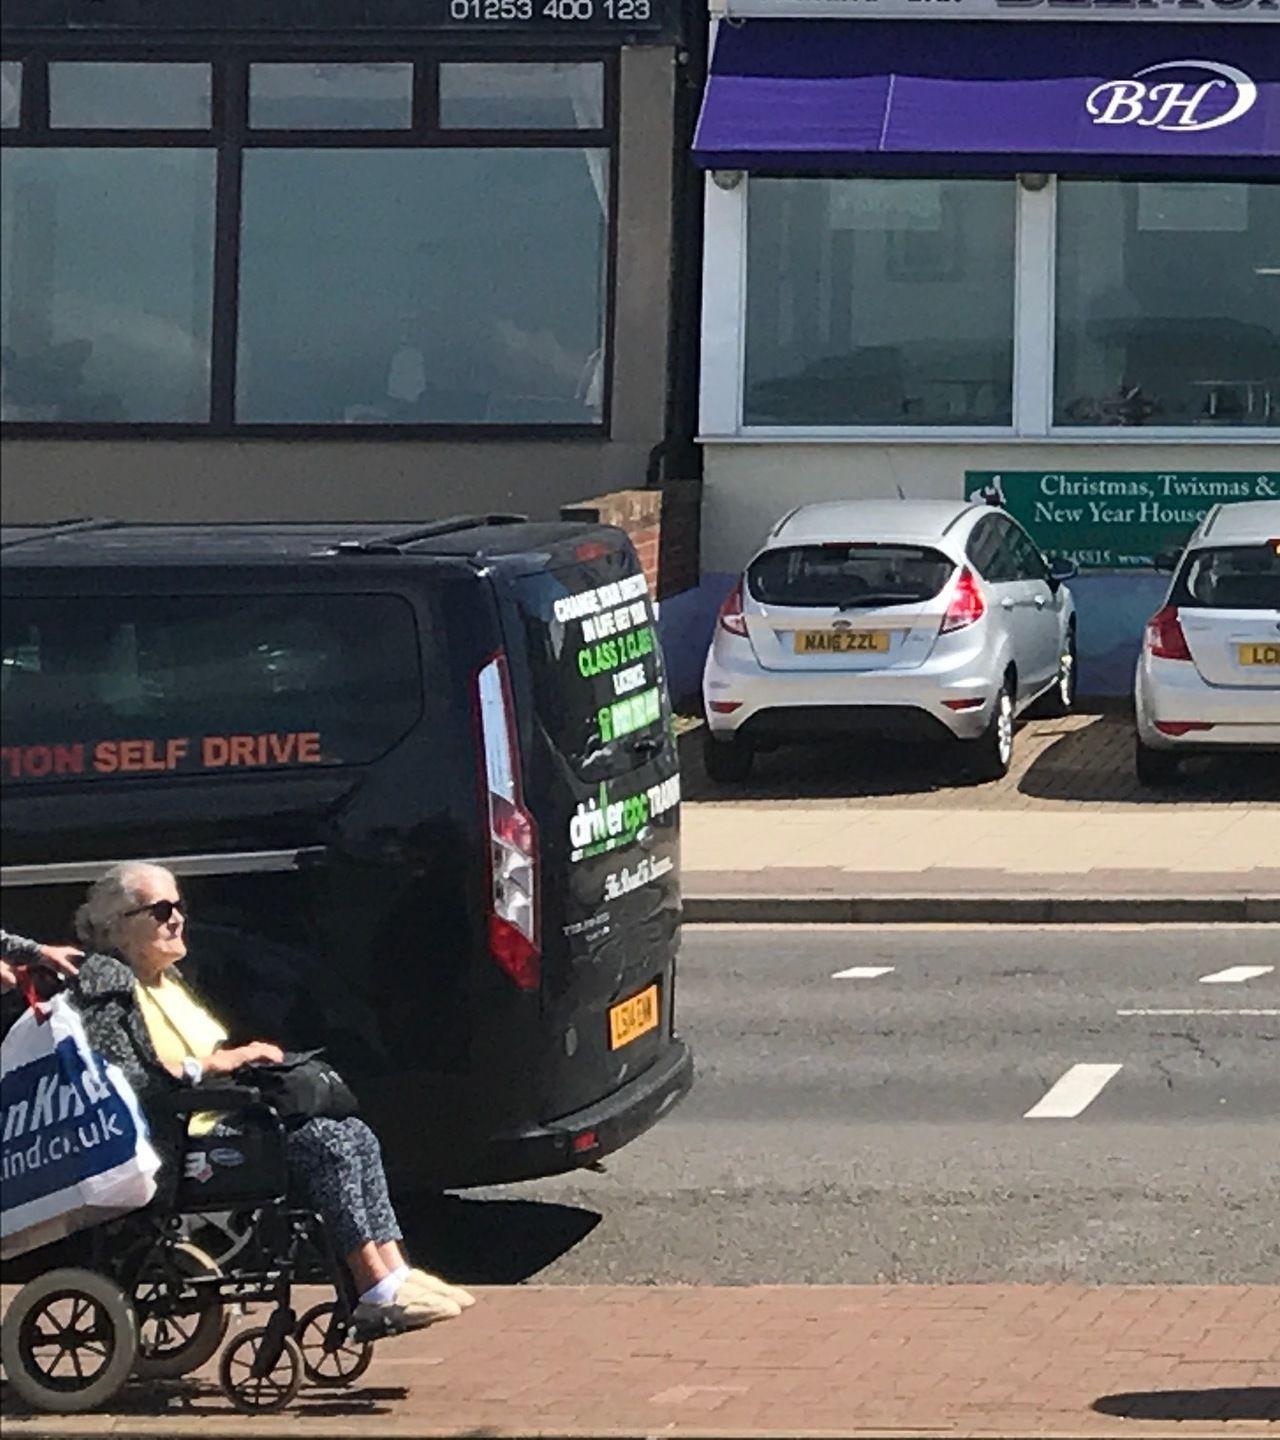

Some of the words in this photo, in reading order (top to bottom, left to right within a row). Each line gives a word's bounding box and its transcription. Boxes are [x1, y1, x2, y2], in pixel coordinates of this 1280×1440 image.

[1039, 474, 1155, 499] Christmas,
[1158, 474, 1250, 497] Twixmas
[1256, 474, 1279, 497] &
[1033, 501, 1085, 523] New
[1088, 501, 1133, 523] Year
[93, 737, 189, 774] SELF
[202, 731, 322, 768] DRIVE
